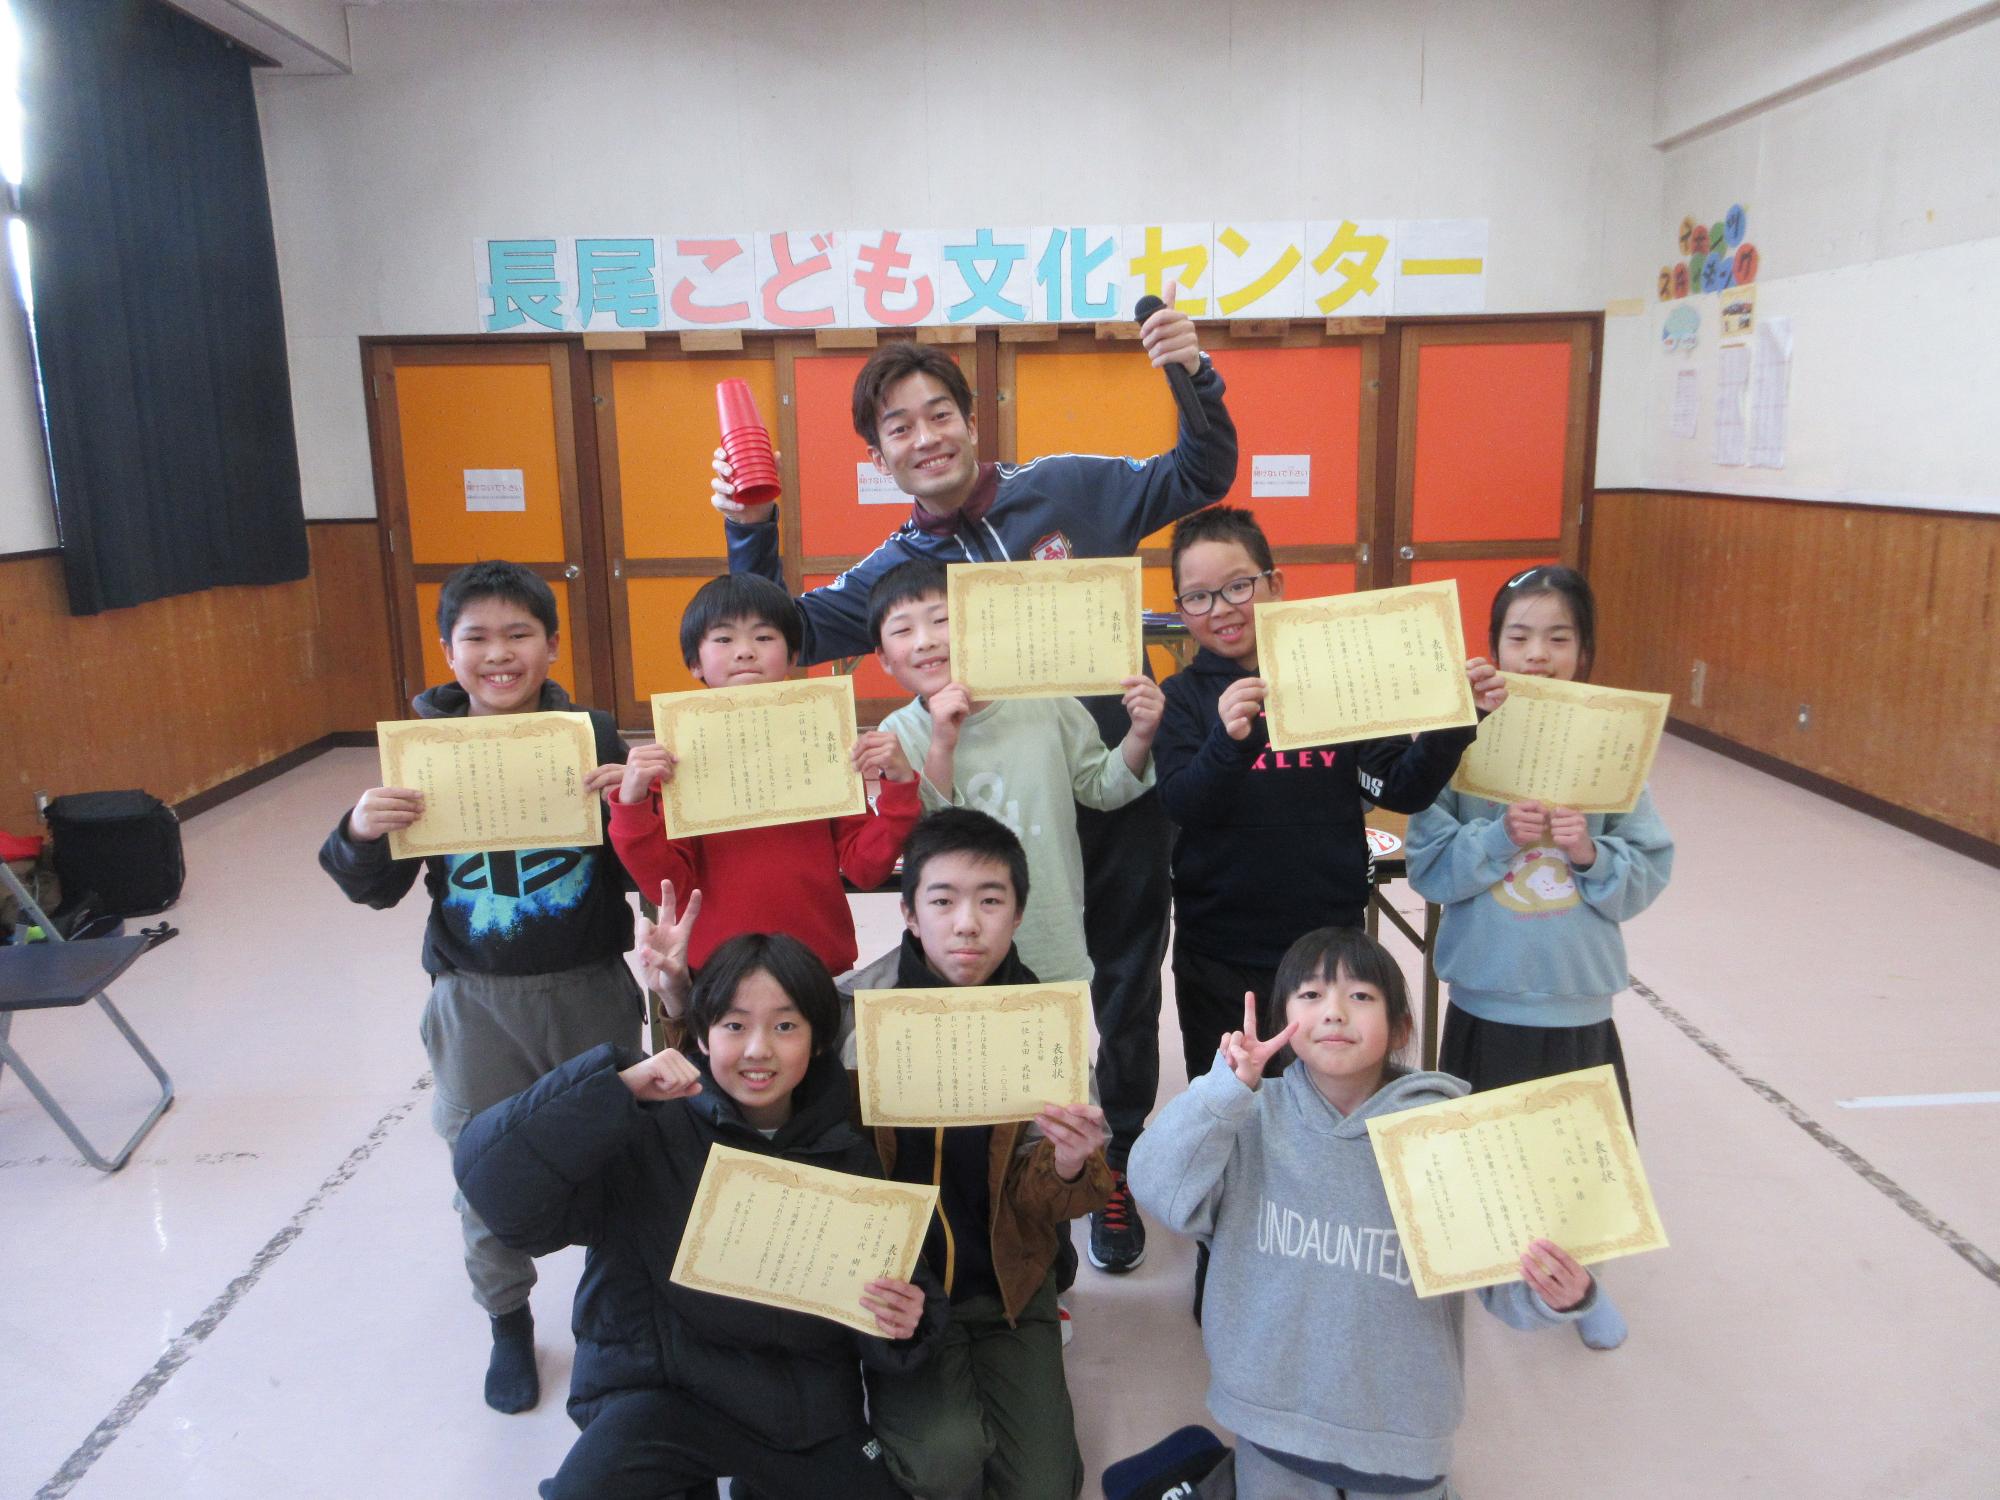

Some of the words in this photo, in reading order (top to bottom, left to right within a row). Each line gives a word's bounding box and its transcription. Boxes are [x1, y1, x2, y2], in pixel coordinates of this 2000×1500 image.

[485, 220, 1483, 332] 長尾こども文化センター
[1051, 1041, 1064, 1079] 表彰状
[1591, 1139, 1617, 1184] 表彰状
